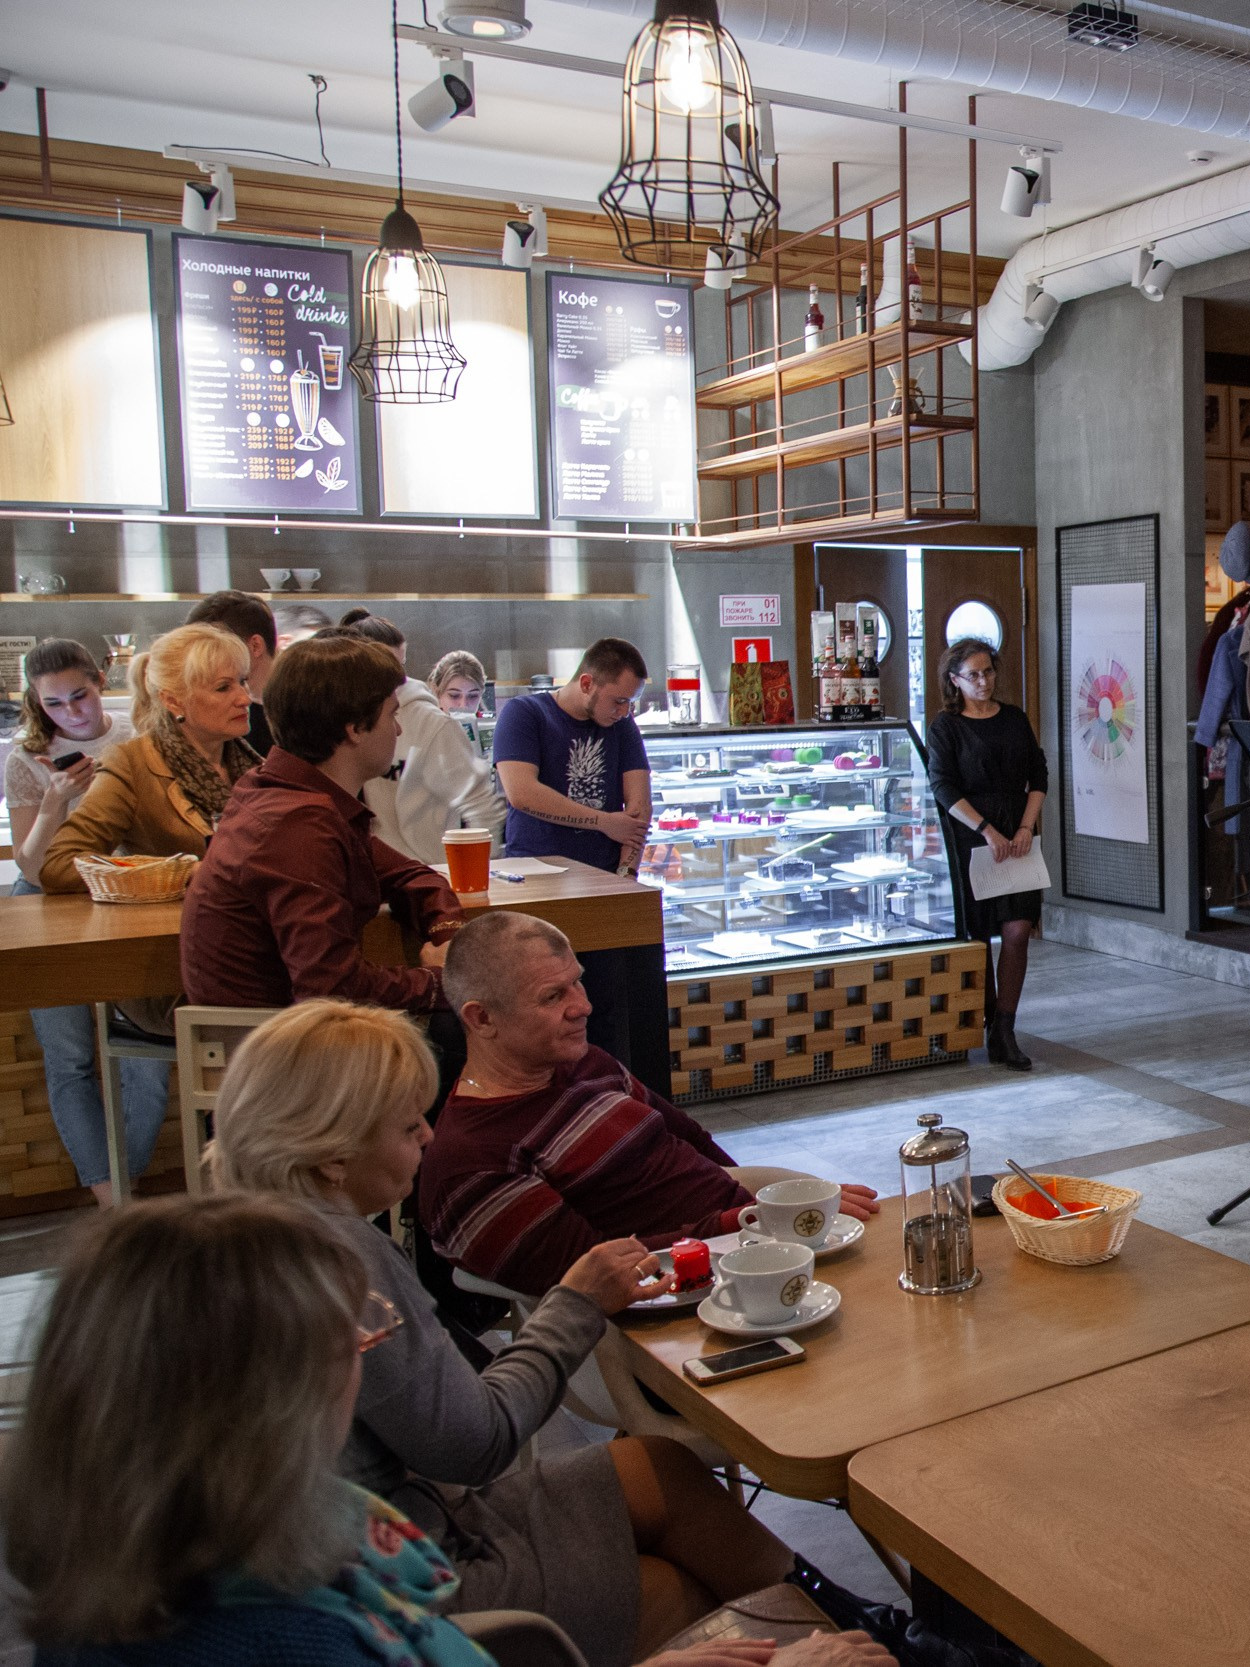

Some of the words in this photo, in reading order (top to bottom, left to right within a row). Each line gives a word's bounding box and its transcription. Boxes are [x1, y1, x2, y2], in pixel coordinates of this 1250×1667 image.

[182, 259, 251, 276] Холодные
[255, 267, 310, 281] напитки
[287, 284, 327, 304] Cold
[558, 290, 598, 309] Кофе
[295, 305, 349, 325] drinks
[764, 598, 775, 609] 01
[759, 612, 776, 622] 112
